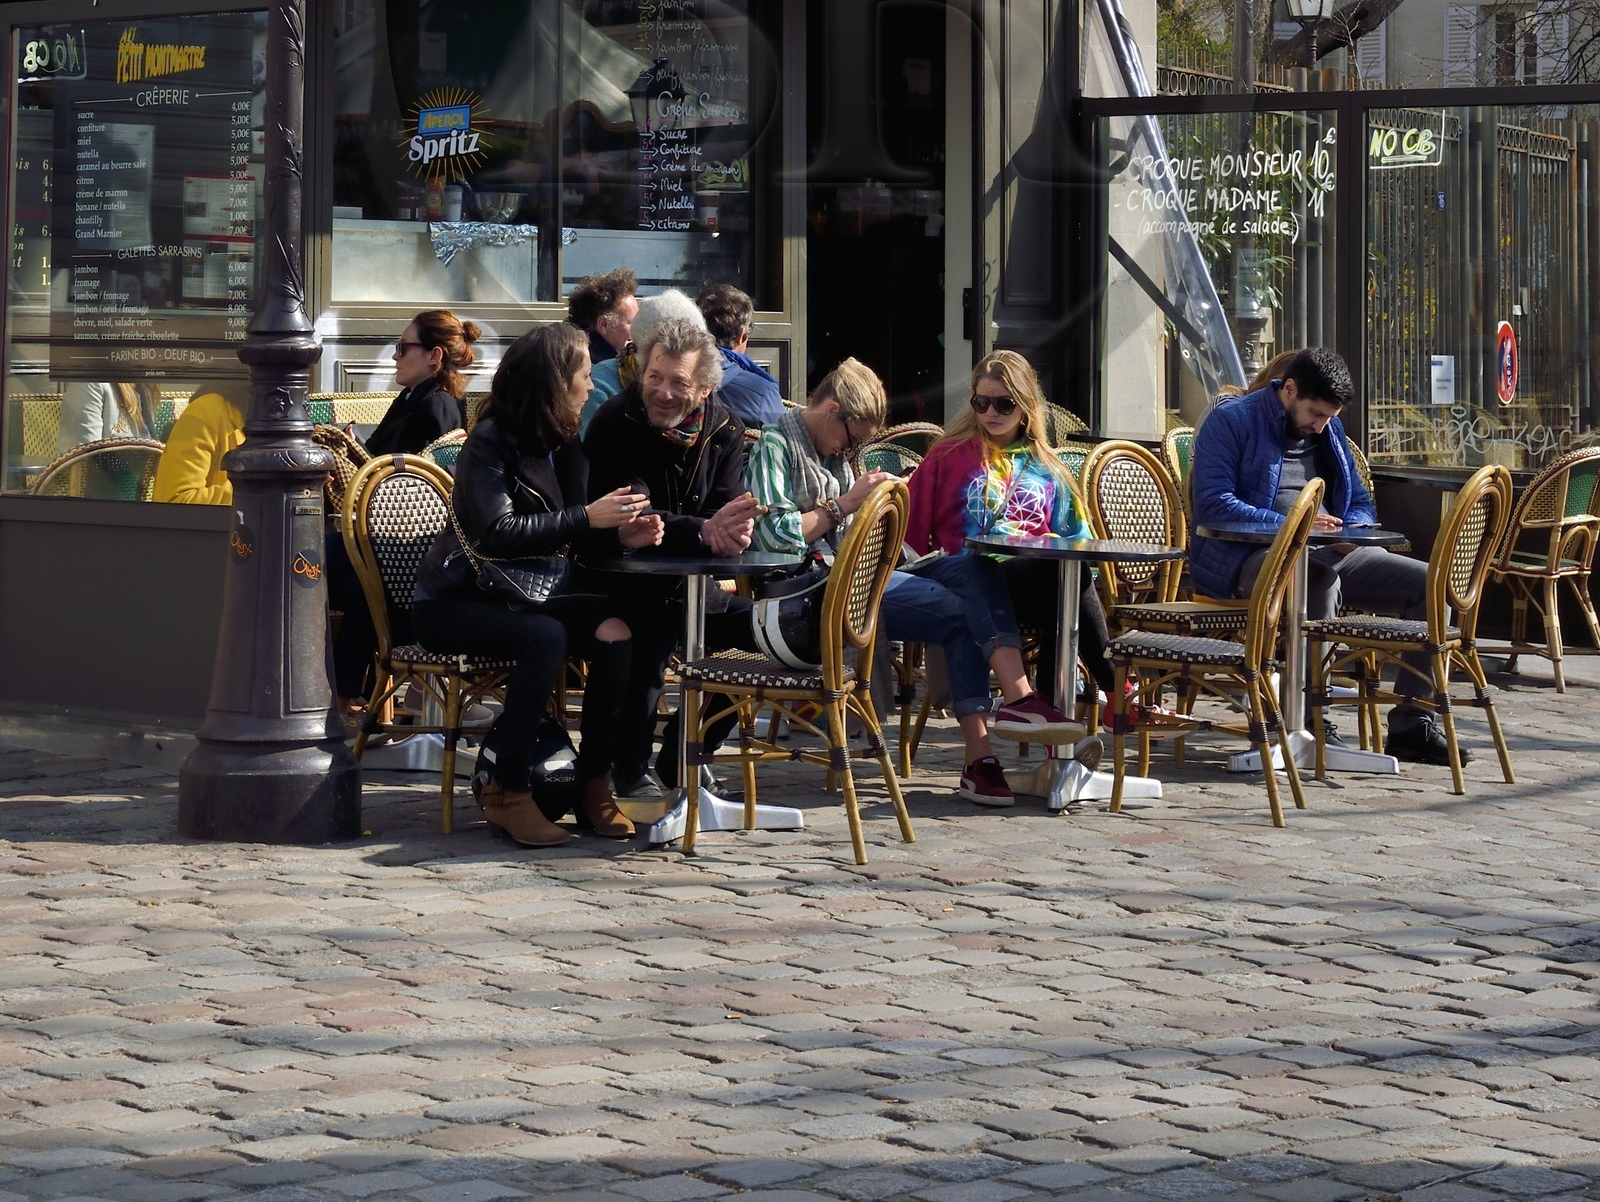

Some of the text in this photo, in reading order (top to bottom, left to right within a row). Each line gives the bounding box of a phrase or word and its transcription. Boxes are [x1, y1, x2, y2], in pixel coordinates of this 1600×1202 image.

[117, 42, 206, 84] PETIT MONTMARTRE
[136, 86, 190, 107] CRÊPERIE
[231, 101, 250, 113] 4,00€
[77, 116, 250, 134] confiture 5,00€
[423, 113, 465, 130] APEROL
[77, 130, 250, 145] miel 5,00€
[1370, 128, 1436, 157] NO CB
[77, 143, 249, 159] nutella 5,00€
[408, 129, 480, 164] Spritz
[76, 162, 100, 172] caramel
[111, 160, 132, 170] beurre
[133, 158, 146, 169] salé
[230, 157, 248, 166] 5,00€
[691, 160, 703, 172] de
[1127, 154, 1203, 181] CROQUE
[1209, 149, 1303, 182] MONSIEUR
[76, 170, 248, 185] citron 5,00€
[660, 177, 684, 192] Miel
[76, 184, 248, 199] crème de marron 5,00€
[76, 203, 98, 212] banane
[101, 201, 126, 211] nutella
[230, 198, 248, 207] 7,00€
[1127, 188, 1198, 212] CROQUE
[1204, 187, 1282, 214] MADAME
[75, 212, 248, 227] chantilly 1,00€
[1222, 217, 1237, 234] de
[75, 226, 248, 239] Grand Marnier 7,00€
[117, 245, 202, 260] GALETTES SARRASINS
[74, 263, 247, 276] jambon 6,00€
[74, 277, 247, 289] fromage 6,00€
[74, 292, 98, 303] jambon
[103, 292, 129, 302] fromage
[228, 290, 247, 300] 7,00€
[74, 305, 98, 316] jambon
[103, 305, 118, 313] oeuf
[122, 305, 149, 316] fromage
[115, 318, 136, 327] salade
[137, 319, 153, 327] verte
[228, 318, 247, 328] 9,00€
[146, 331, 180, 341] ciboulette
[224, 331, 247, 341] 12,00€
[111, 348, 205, 363] FARINE BIO OEUF BIO
